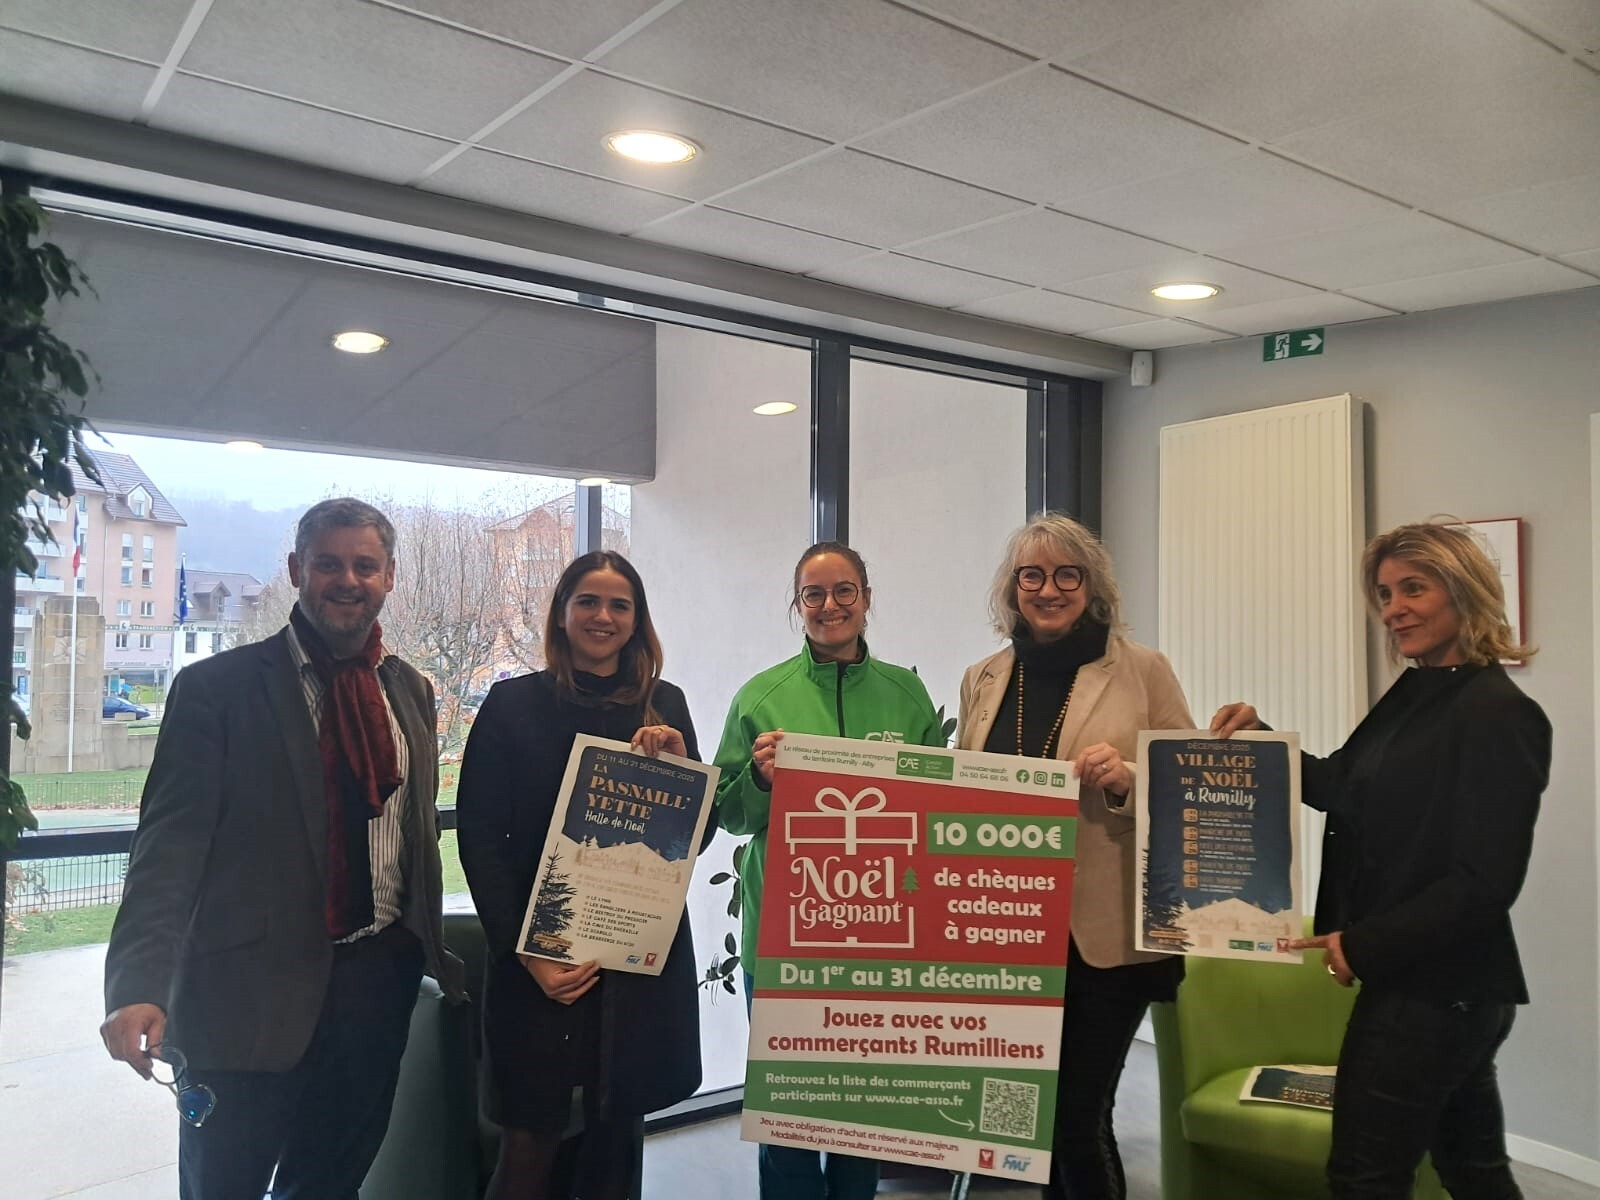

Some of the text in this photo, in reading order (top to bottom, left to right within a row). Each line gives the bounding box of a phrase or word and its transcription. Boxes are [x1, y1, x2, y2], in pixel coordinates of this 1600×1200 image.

[592, 764, 608, 774] LA
[837, 758, 858, 767] Rumilly
[862, 754, 896, 762] entreprises
[899, 758, 920, 770] CAE
[1176, 754, 1256, 768] VILLAGE
[617, 758, 628, 766] AU
[631, 760, 638, 768] 21
[639, 761, 676, 777] DÉCEMBRE
[677, 772, 696, 782] 2025
[1201, 769, 1258, 788] NOËL
[588, 793, 652, 820] YETTE
[1184, 787, 1256, 810] à Rumilly
[585, 810, 609, 824] Halle
[611, 816, 622, 828] de
[934, 822, 1062, 850] 10 000€
[790, 856, 895, 902] Noël
[934, 868, 1055, 892] de chèques
[800, 898, 902, 929] Gagnant
[948, 896, 1042, 917] cadeaux
[944, 920, 1046, 945] à gagner
[780, 963, 1042, 992] Du 1er au 31 décembre
[823, 1006, 987, 1031] Jouez avec vos
[768, 1035, 1044, 1060] commerçants Rumilliens
[766, 1072, 971, 1092] Retrouvez la liste des commerçants
[770, 1090, 964, 1107] participants sur www.cae-asso.fr
[760, 1117, 958, 1152] Jeu avec obligation d'achat et réservé aux majeurs
[770, 1130, 806, 1142] Modalités
[806, 1134, 817, 1144] du
[817, 1137, 829, 1146] jeu
[830, 1137, 836, 1145] à
[836, 1139, 870, 1150] consulter
[872, 1145, 882, 1153] sur
